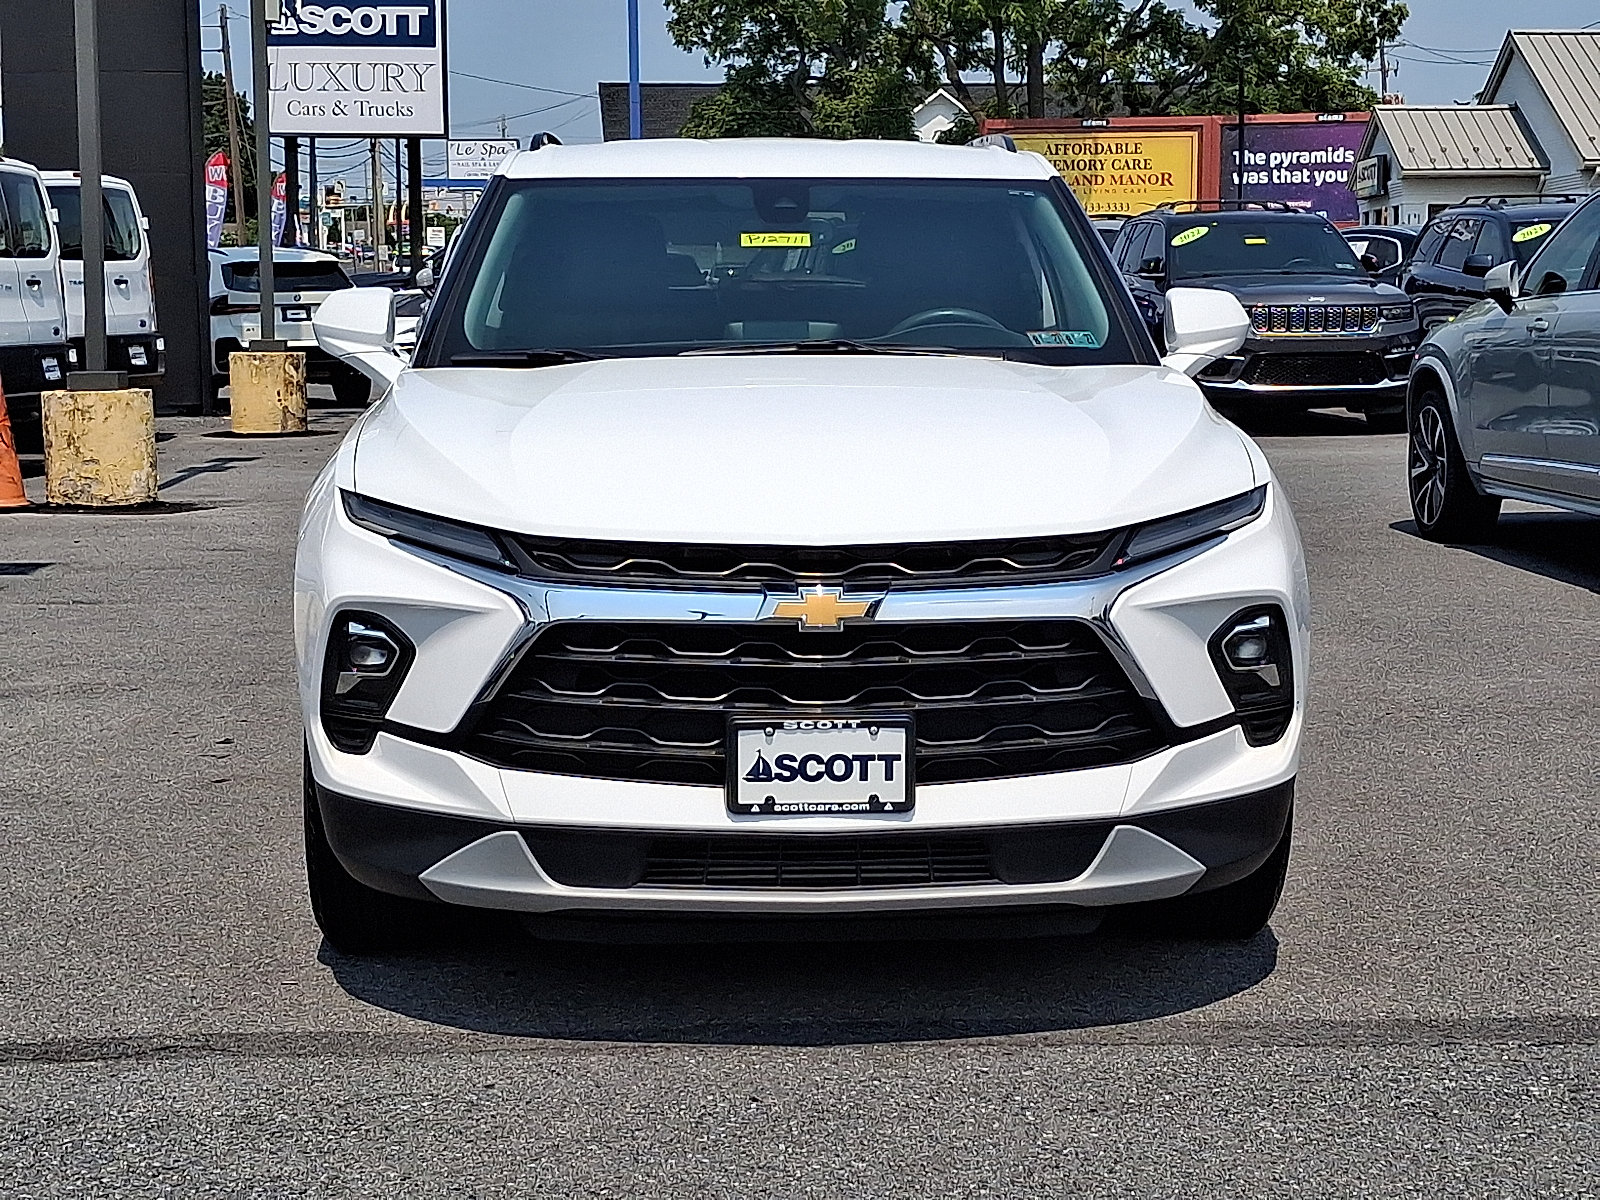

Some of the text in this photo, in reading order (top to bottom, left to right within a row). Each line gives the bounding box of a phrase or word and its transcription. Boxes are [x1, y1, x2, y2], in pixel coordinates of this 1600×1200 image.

[299, 5, 429, 36] SCOTT
[267, 62, 437, 93] LUXURY
[287, 100, 414, 117] Cars & Trucks
[480, 142, 508, 159] Spa
[1044, 142, 1143, 156] AFFORDABLE
[1232, 146, 1355, 168] The pyramids
[1049, 158, 1153, 172] EMORY CARE
[1062, 171, 1174, 187] LAND MANOR
[1272, 168, 1312, 184] that
[1313, 169, 1348, 186] you
[783, 720, 862, 730] SCOTT
[774, 753, 902, 783] SCOTT
